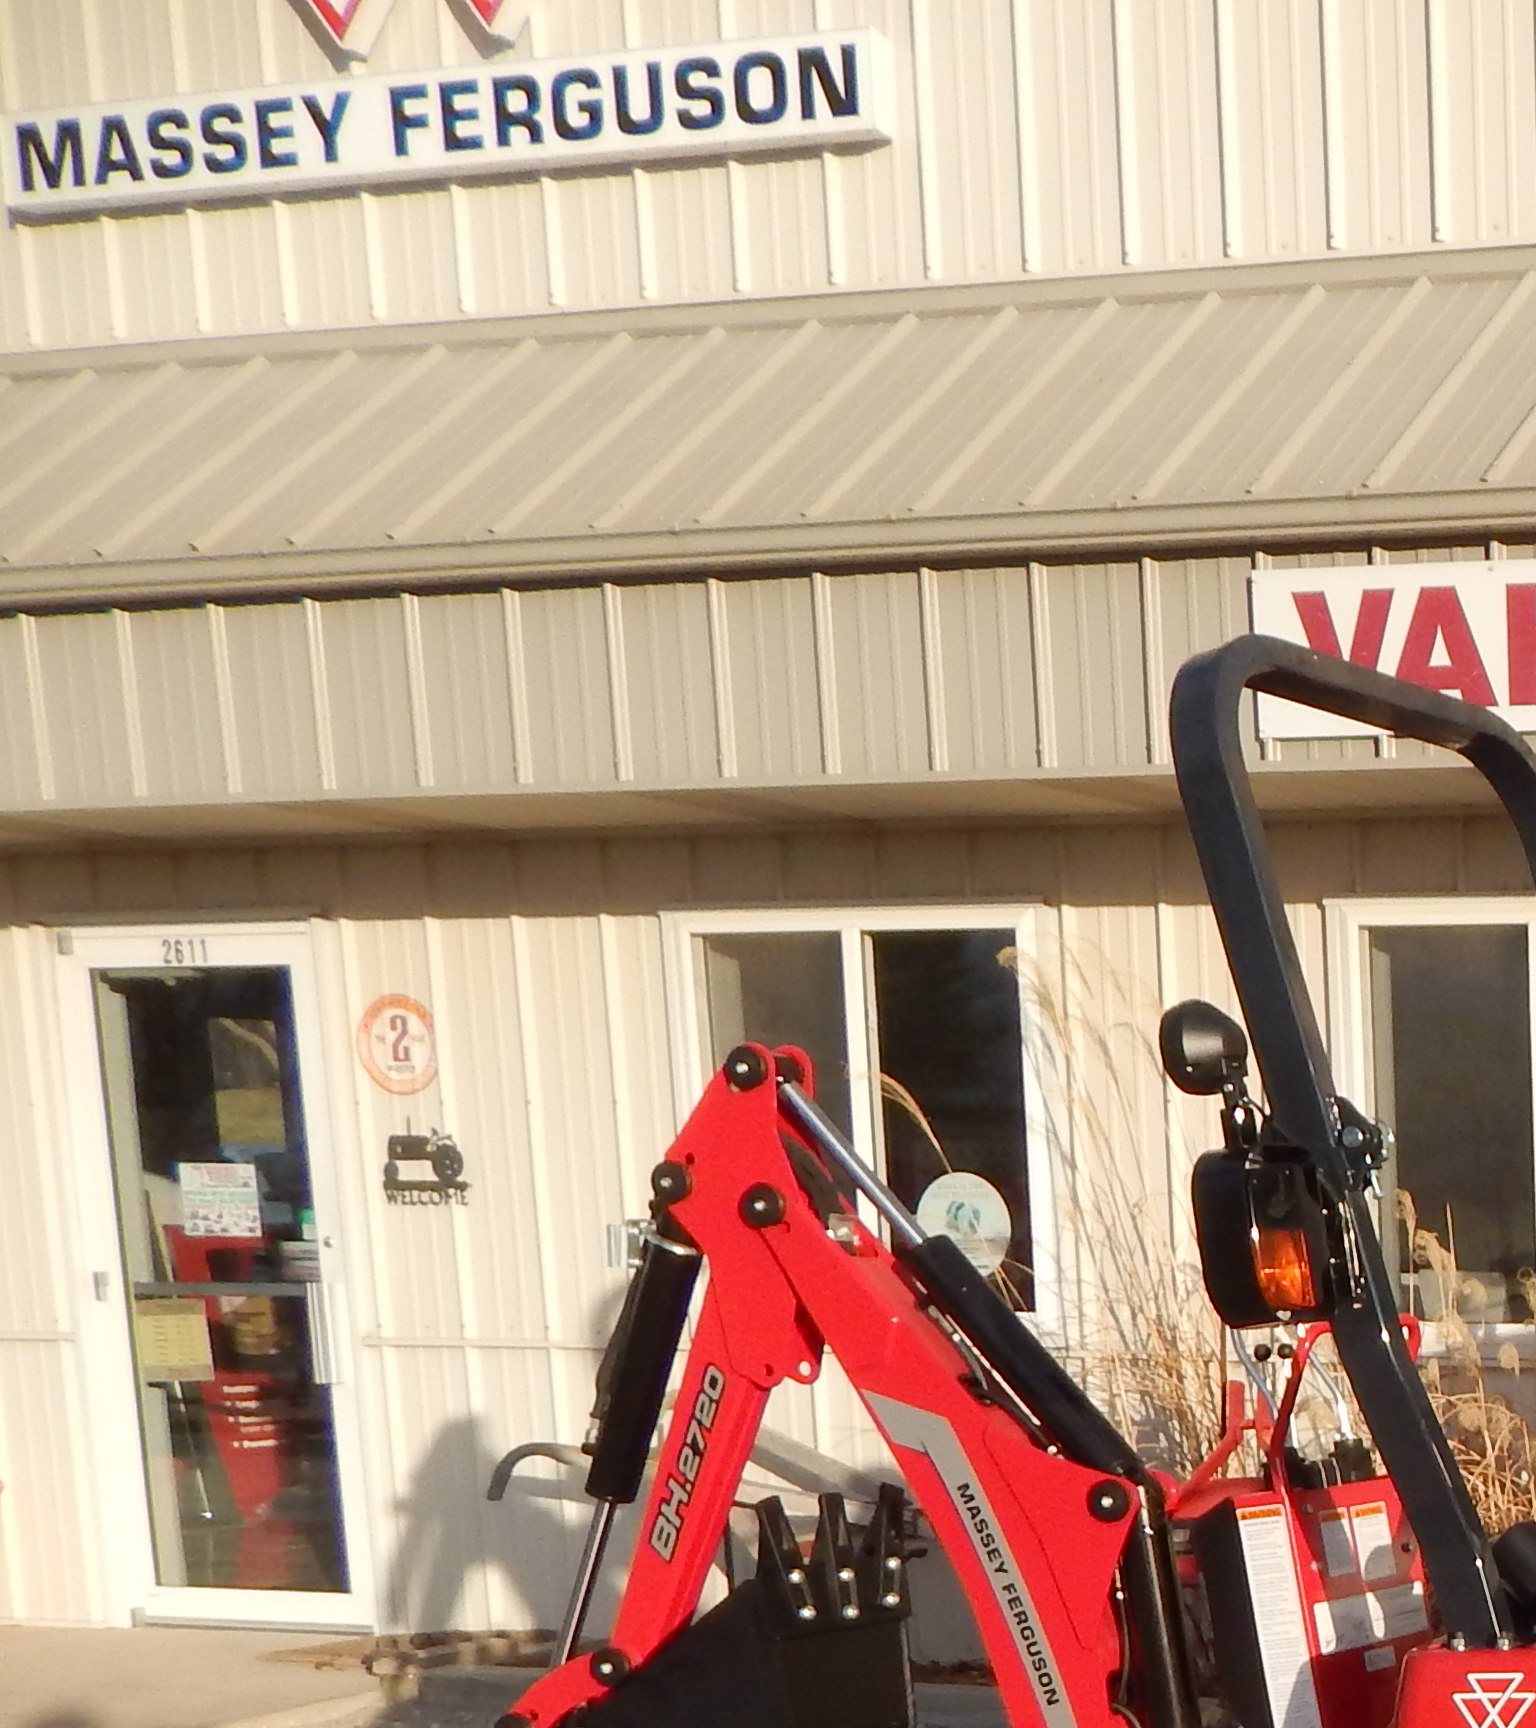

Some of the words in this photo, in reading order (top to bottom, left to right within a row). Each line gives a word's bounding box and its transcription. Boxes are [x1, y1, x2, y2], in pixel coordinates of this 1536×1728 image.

[15, 91, 351, 191] MASSEY
[389, 43, 860, 157] FERGUSON
[162, 938, 208, 965] 2611
[385, 1187, 469, 1206] WELCOME
[650, 1363, 726, 1562] BH.2720
[956, 1482, 1009, 1575] MASSEY
[1002, 1582, 1060, 1706] FERGUSON
